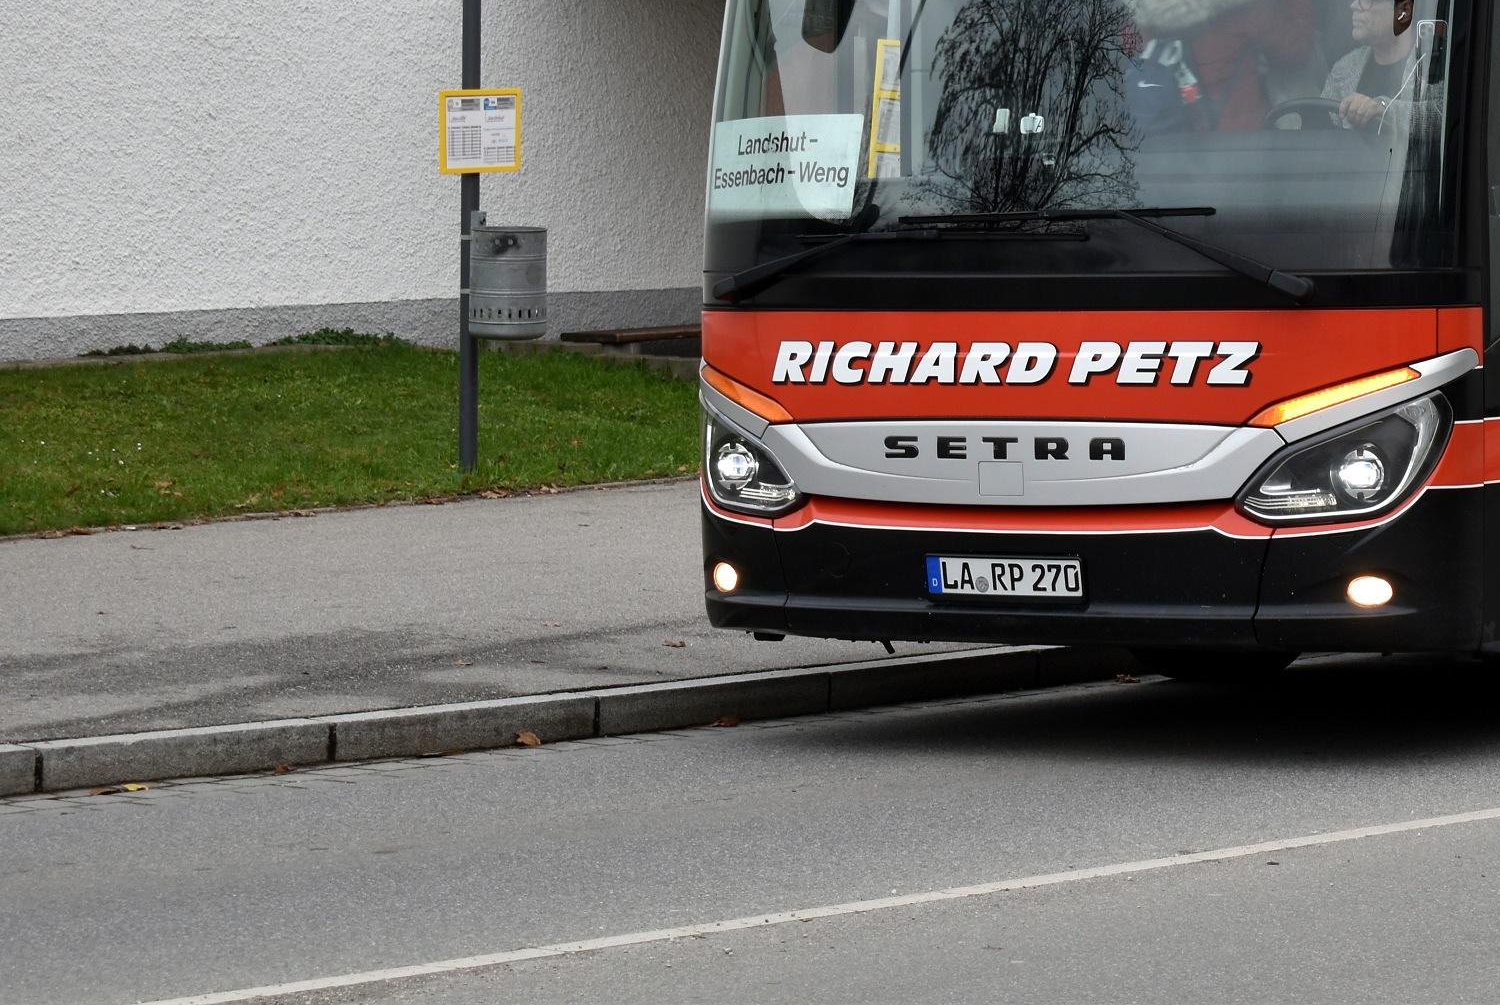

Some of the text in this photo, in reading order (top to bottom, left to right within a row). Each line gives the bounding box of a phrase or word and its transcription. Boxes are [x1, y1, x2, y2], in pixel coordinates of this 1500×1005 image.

[772, 340, 1262, 386] RICHARD PETZ
[884, 435, 1126, 461] SETRA
[942, 561, 1080, 592] LA RP 270
